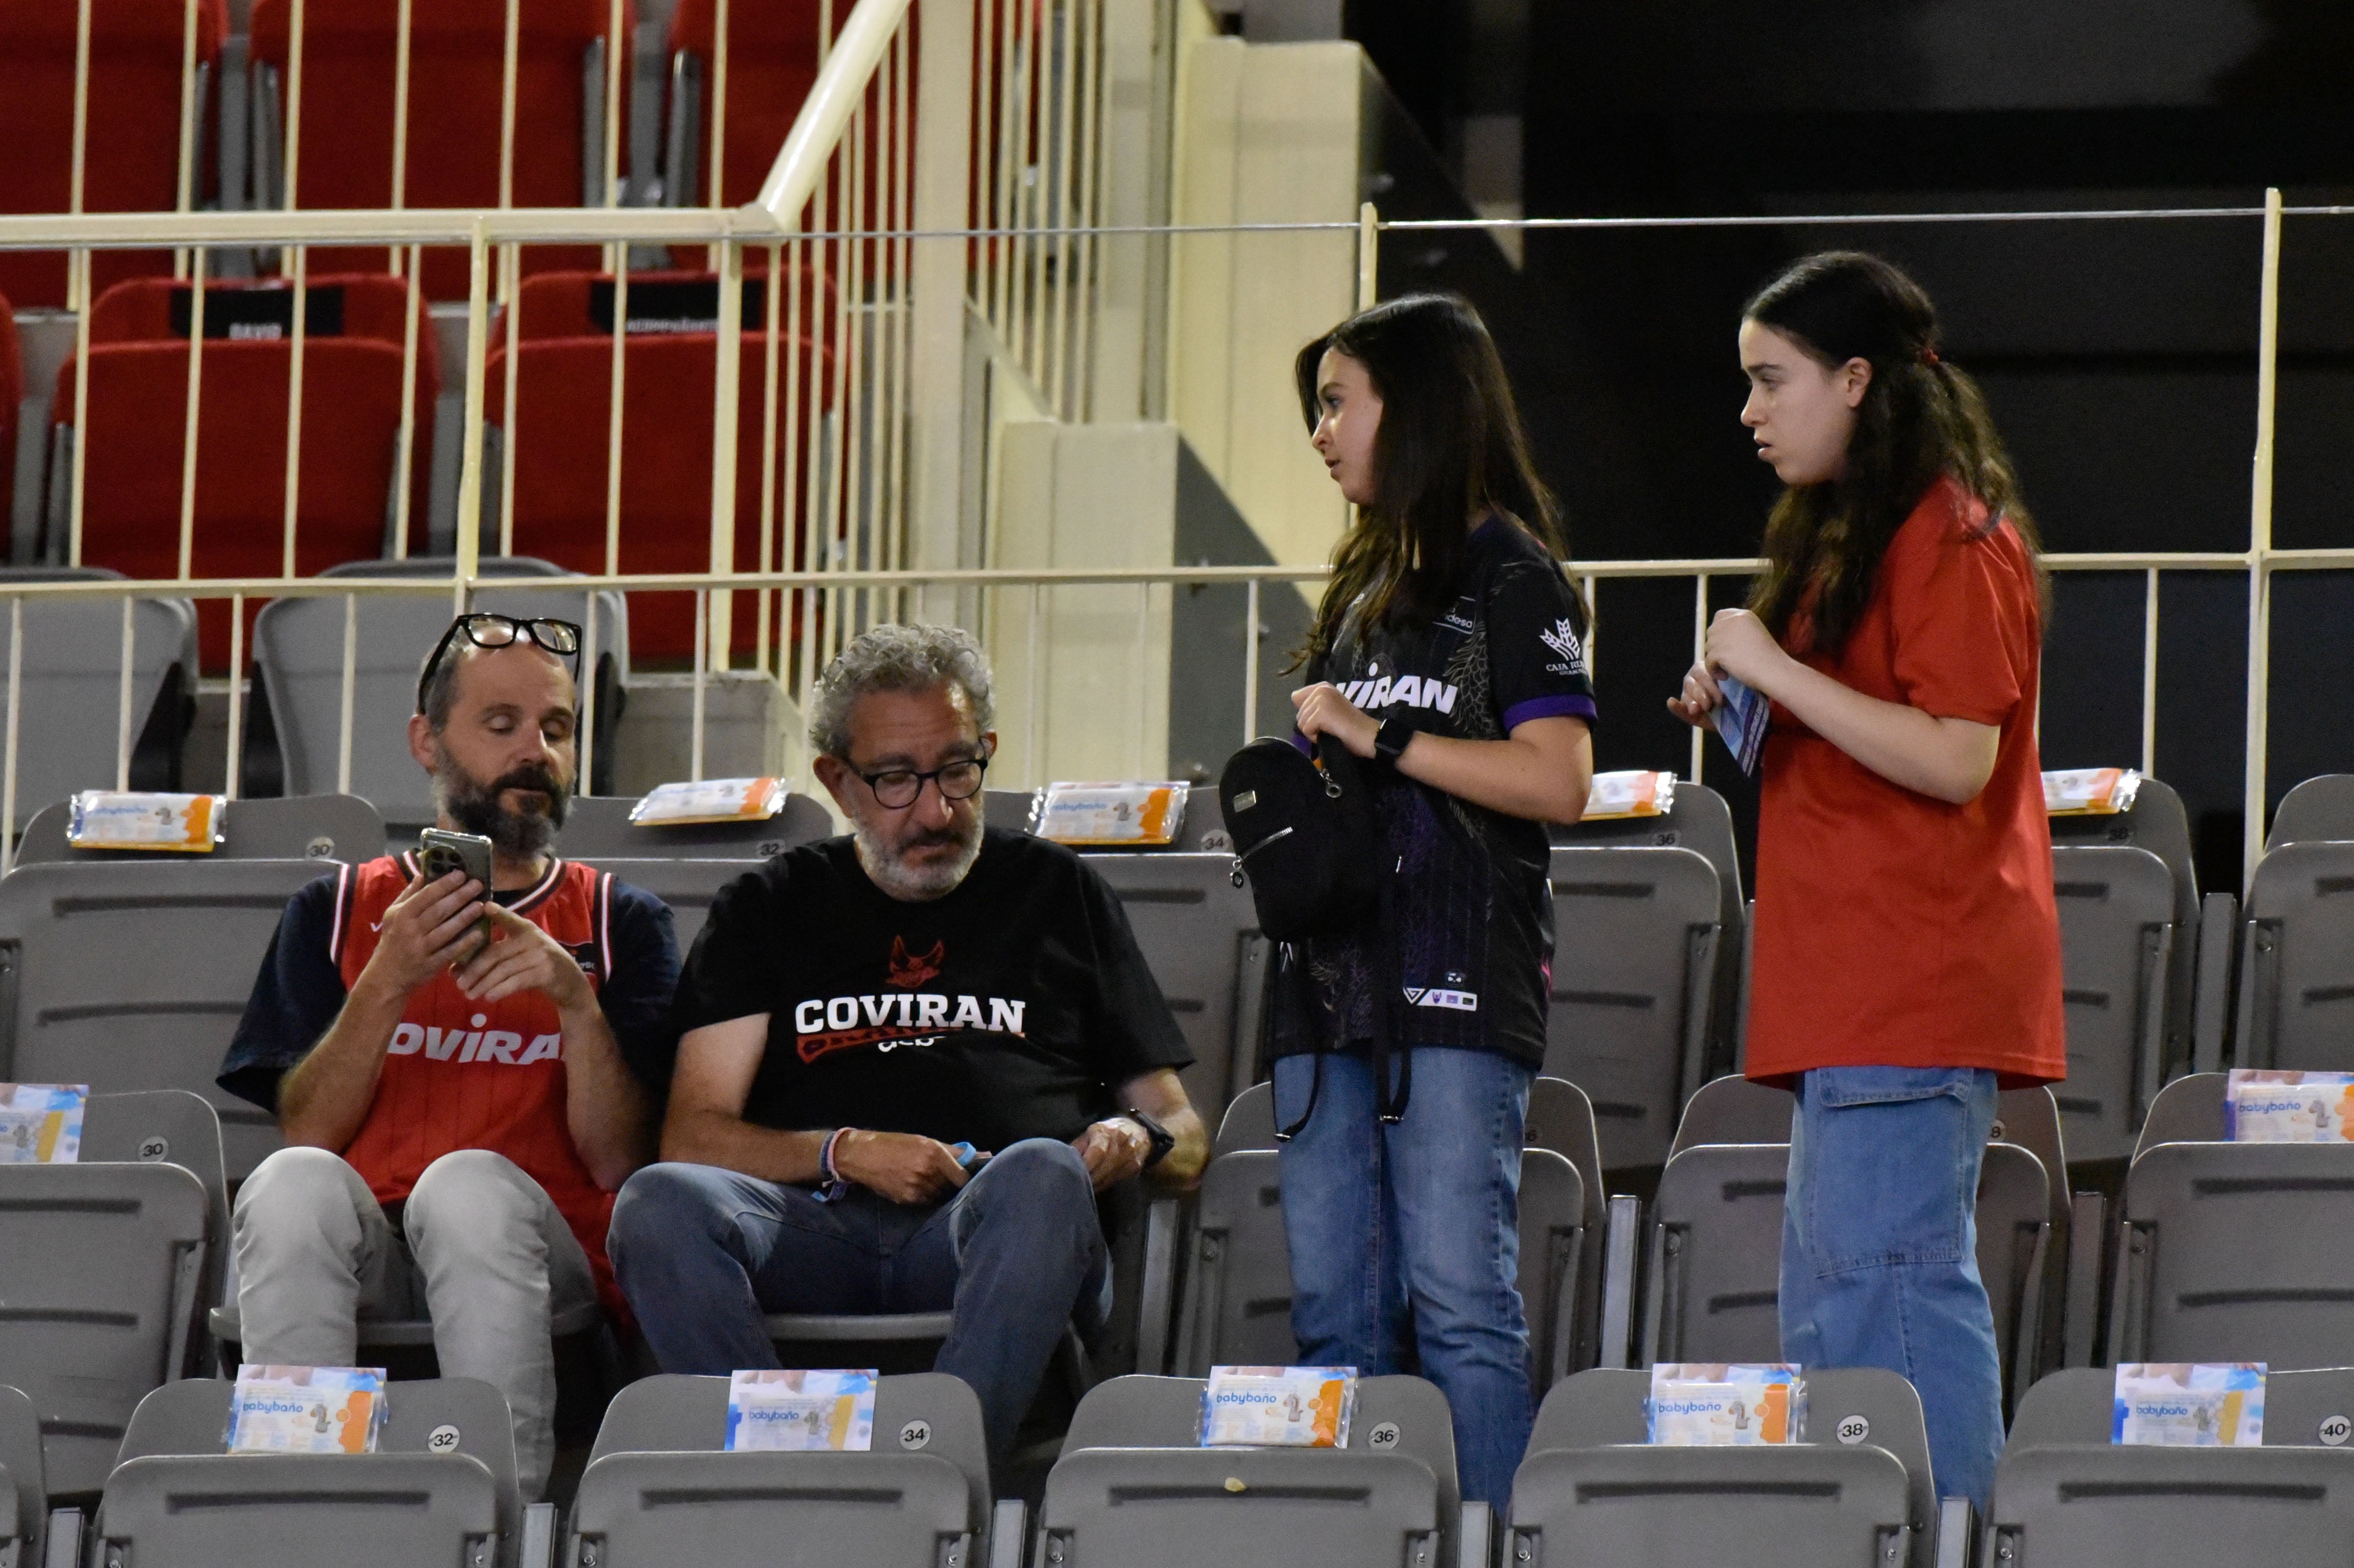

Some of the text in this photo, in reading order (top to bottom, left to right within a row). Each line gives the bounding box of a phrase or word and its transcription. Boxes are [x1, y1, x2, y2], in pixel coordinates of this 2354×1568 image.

[1445, 614, 1473, 628] desa
[1204, 837, 1224, 850] 34
[1656, 833, 1675, 846] 36
[310, 844, 330, 857] 30
[760, 843, 779, 856] 32
[796, 994, 1025, 1033] COVIRAN
[1990, 1126, 2001, 1138] 8
[143, 1143, 164, 1157] 30
[1216, 1392, 1277, 1405] babybaño
[243, 1400, 303, 1414] babybaño
[1658, 1401, 1722, 1415] babybaño
[2136, 1405, 2188, 1416] babybaño
[749, 1410, 800, 1421] babybaño
[904, 1428, 925, 1442] 34
[1373, 1430, 1394, 1443] 36
[1842, 1423, 1864, 1437] 38
[2324, 1423, 2346, 1437] 40
[434, 1433, 453, 1447] 32
